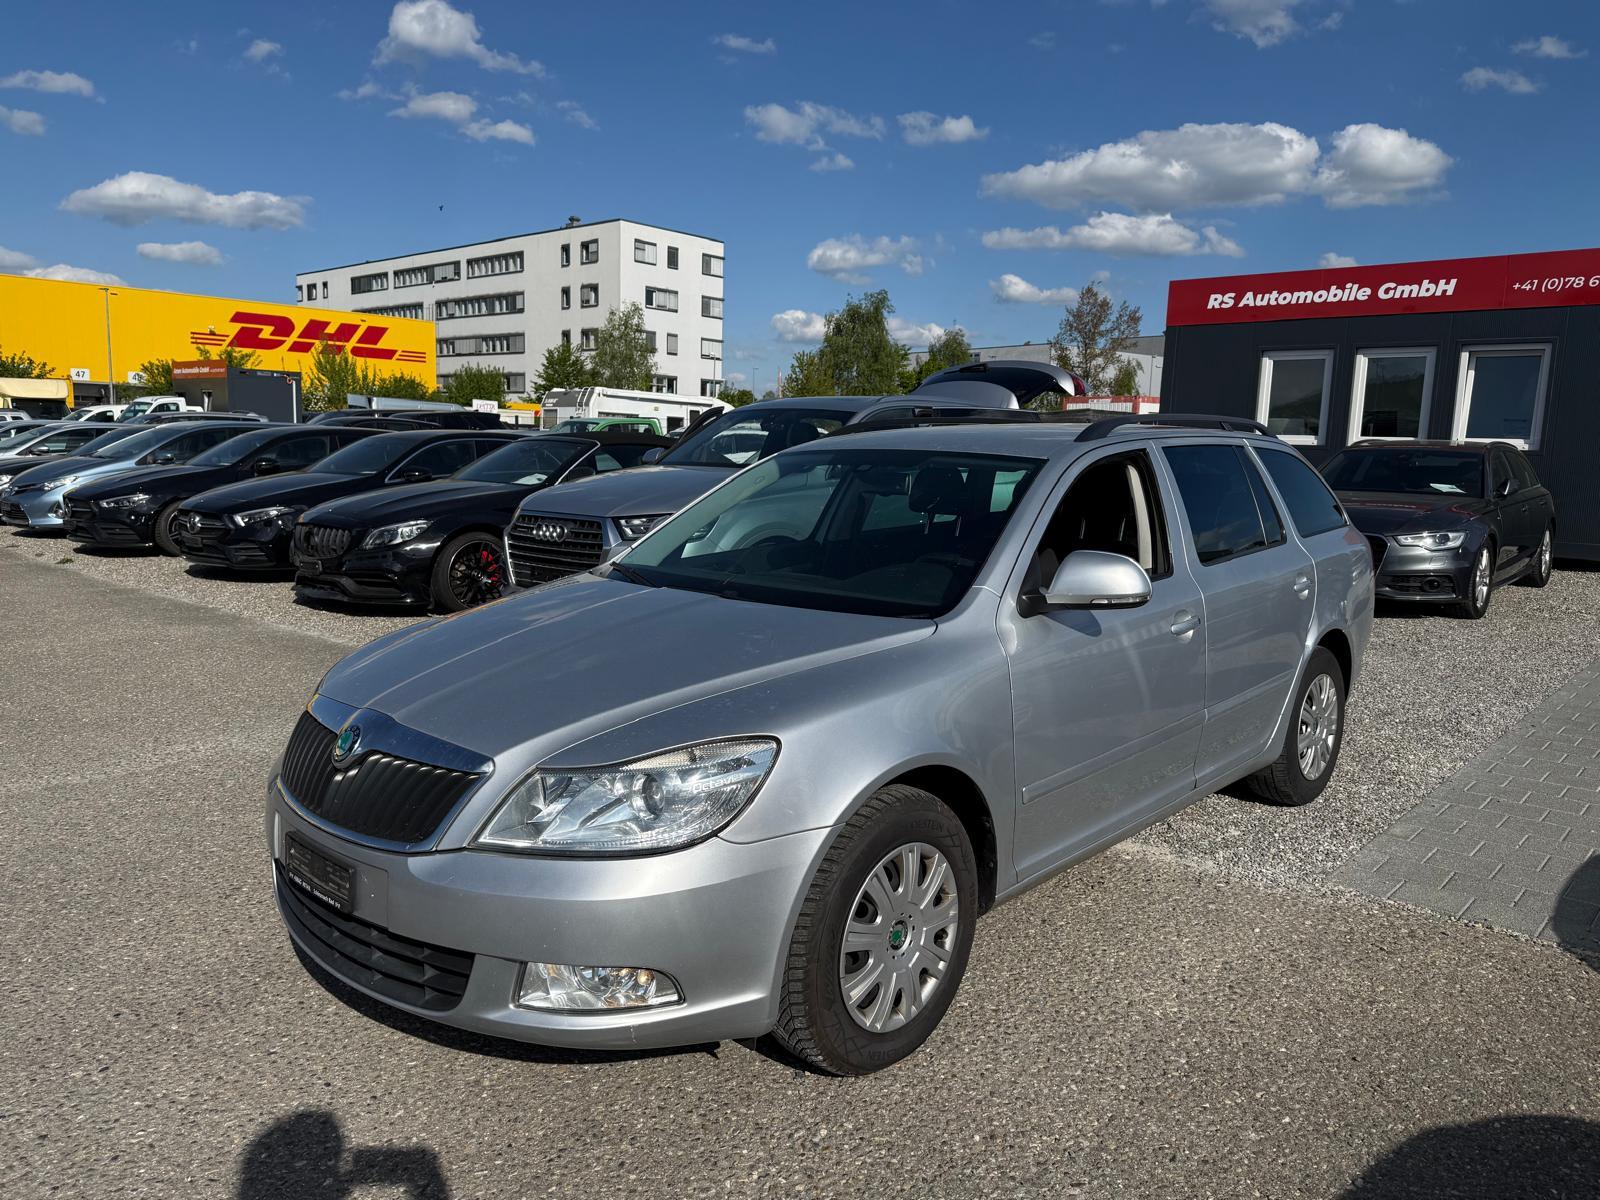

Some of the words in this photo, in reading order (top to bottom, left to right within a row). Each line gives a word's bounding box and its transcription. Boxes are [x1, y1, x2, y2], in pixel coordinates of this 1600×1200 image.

[1206, 292, 1236, 309] RS
[1238, 283, 1372, 308] Automobile
[1377, 278, 1458, 300] GmbH
[1512, 279, 1538, 291] +41
[1541, 276, 1585, 292] (0)78
[226, 311, 399, 360] DHL
[75, 370, 86, 378] 47
[693, 772, 744, 791] Octavia
